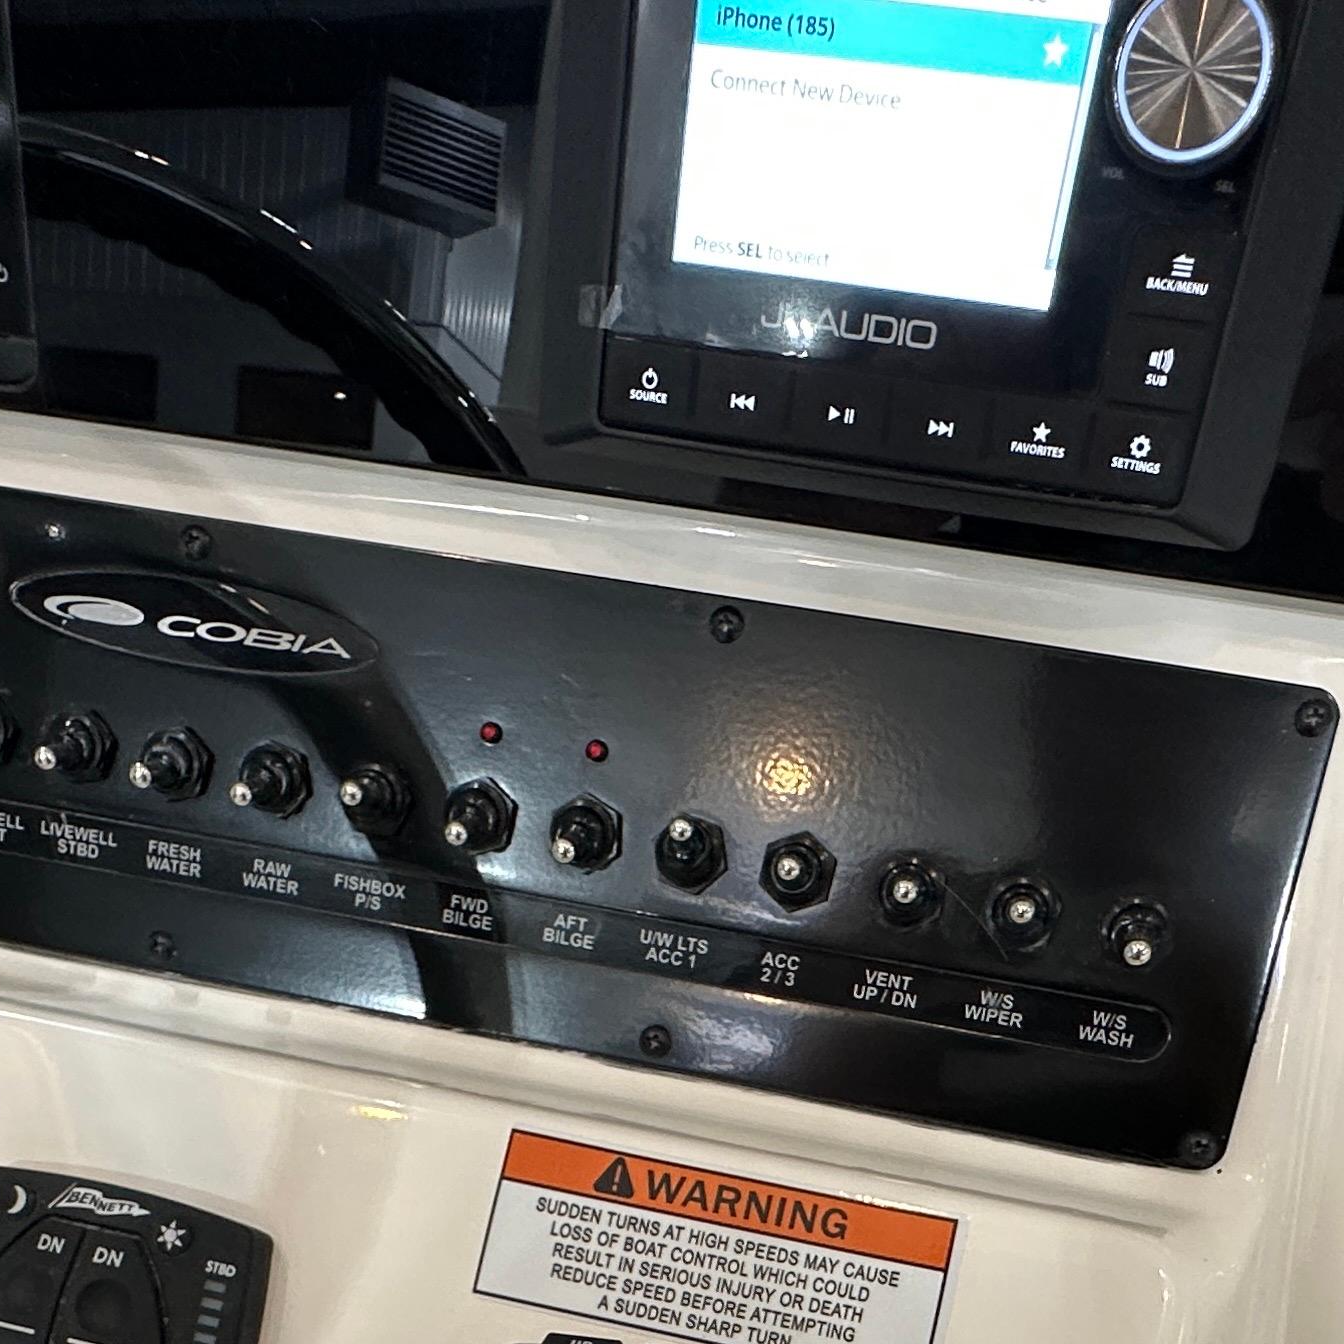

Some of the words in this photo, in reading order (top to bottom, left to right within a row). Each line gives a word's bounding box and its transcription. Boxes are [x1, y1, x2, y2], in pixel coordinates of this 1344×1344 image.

[716, 7, 783, 32] iPhone
[787, 14, 835, 42] (185)
[710, 68, 788, 97] Connect
[793, 80, 834, 103] New
[839, 83, 902, 110] Device
[693, 235, 734, 255] Press
[737, 242, 763, 260] SEL
[1145, 276, 1209, 296] BACK/MENU
[817, 307, 938, 350] AUDIO
[1144, 373, 1168, 387] SUB
[629, 388, 668, 404] SOURCE
[1010, 440, 1065, 459] FAVORITES
[1110, 455, 1161, 475] SETTINGS
[157, 614, 351, 659] COBIA
[40, 820, 118, 848] LIVEWELL
[57, 838, 99, 859] STBD
[148, 839, 201, 862] FRESH
[146, 854, 202, 878] WATER
[253, 858, 292, 878] RAW
[242, 872, 299, 896] WATER
[333, 872, 406, 899] FISHBOX
[354, 892, 382, 911] P/S
[450, 894, 489, 914] FWD
[442, 908, 493, 931] BILGE
[553, 913, 589, 932] AFT
[542, 927, 595, 950] BILGE
[639, 928, 674, 948] U/W
[677, 935, 709, 955] LTS
[644, 947, 683, 966] ACC
[688, 954, 696, 969] 1
[760, 952, 800, 975] ACC
[864, 969, 914, 993] VENT
[981, 990, 1014, 1010] W/S
[965, 1003, 1023, 1029] WIPER
[1093, 1010, 1127, 1031] W/S
[1079, 1024, 1134, 1049] WASH
[67, 1188, 137, 1213] BENNETT
[647, 1169, 849, 1241] WARNING
[37, 1232, 67, 1254] DN
[535, 1196, 603, 1225] SUDDEN
[607, 1210, 661, 1237] TURNS
[662, 1224, 686, 1242] AT
[687, 1228, 730, 1252] HIGH
[733, 1238, 800, 1267] SPEEDS
[803, 1253, 840, 1275] MAY
[843, 1261, 901, 1288] CAUSE
[92, 1246, 124, 1268] DN
[549, 1220, 593, 1244] LOSS
[596, 1230, 621, 1248] OF
[623, 1236, 668, 1259] BOAT
[670, 1246, 749, 1278] CONTROL
[753, 1263, 809, 1290] WHICH
[812, 1276, 870, 1303] COULD
[205, 1260, 236, 1278] STBD
[551, 1242, 616, 1269] RESULT
[617, 1256, 636, 1274] IN
[638, 1261, 712, 1291] SERIOUS
[715, 1277, 777, 1304] INJURY
[779, 1291, 805, 1311] OR
[807, 1297, 864, 1324] DEATH
[550, 1262, 619, 1292] REDUCE
[621, 1278, 677, 1304] SPEED
[679, 1290, 748, 1320] BEFORE
[749, 1306, 856, 1343] ATTEMPTING
[597, 1294, 609, 1311] A
[613, 1297, 682, 1327] SUDDEN
[685, 1313, 743, 1339] SHARP
